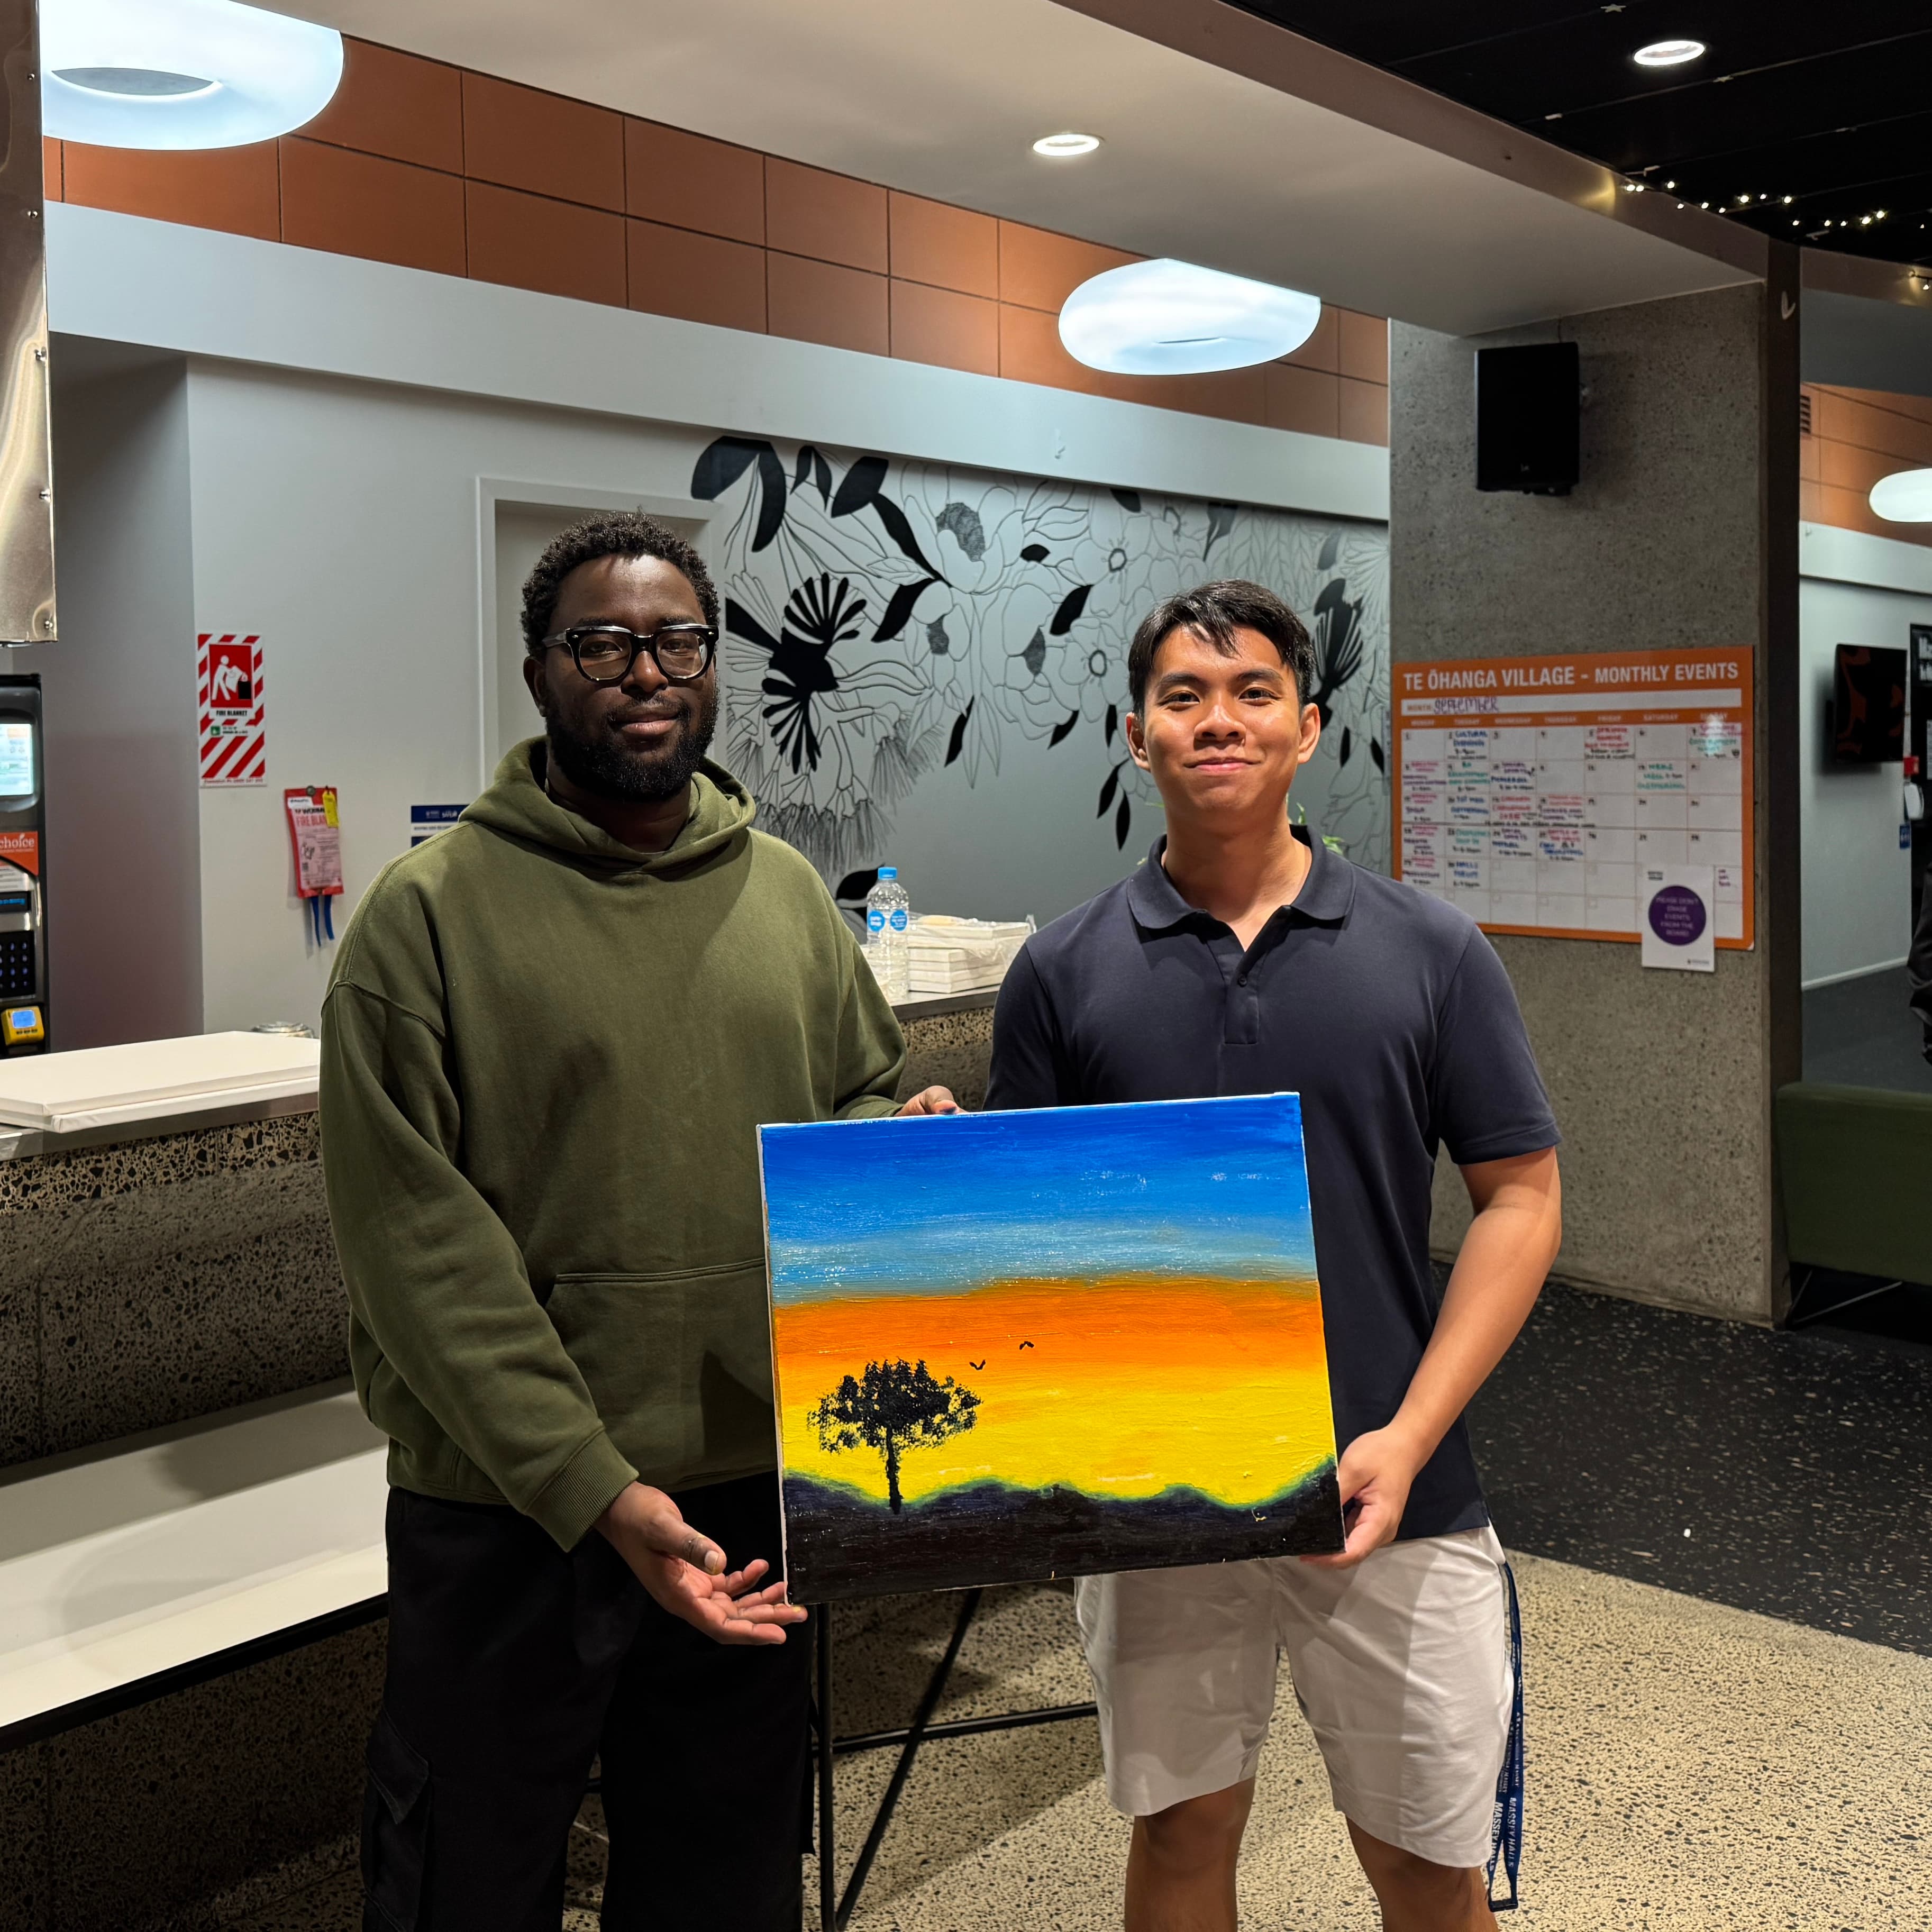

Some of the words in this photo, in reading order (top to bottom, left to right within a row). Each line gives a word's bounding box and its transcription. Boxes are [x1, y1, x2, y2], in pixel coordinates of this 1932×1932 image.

[1404, 672, 1423, 690] TE
[1427, 668, 1498, 690] ŌHANGA
[1502, 666, 1575, 687] VILLAGE
[1595, 665, 1670, 684] MONTHLY
[1675, 662, 1739, 681] EVENTS
[1492, 1801, 1503, 1840] MASSEY
[1508, 1797, 1517, 1837] MASSEY
[1508, 1838, 1516, 1867] HALLS
